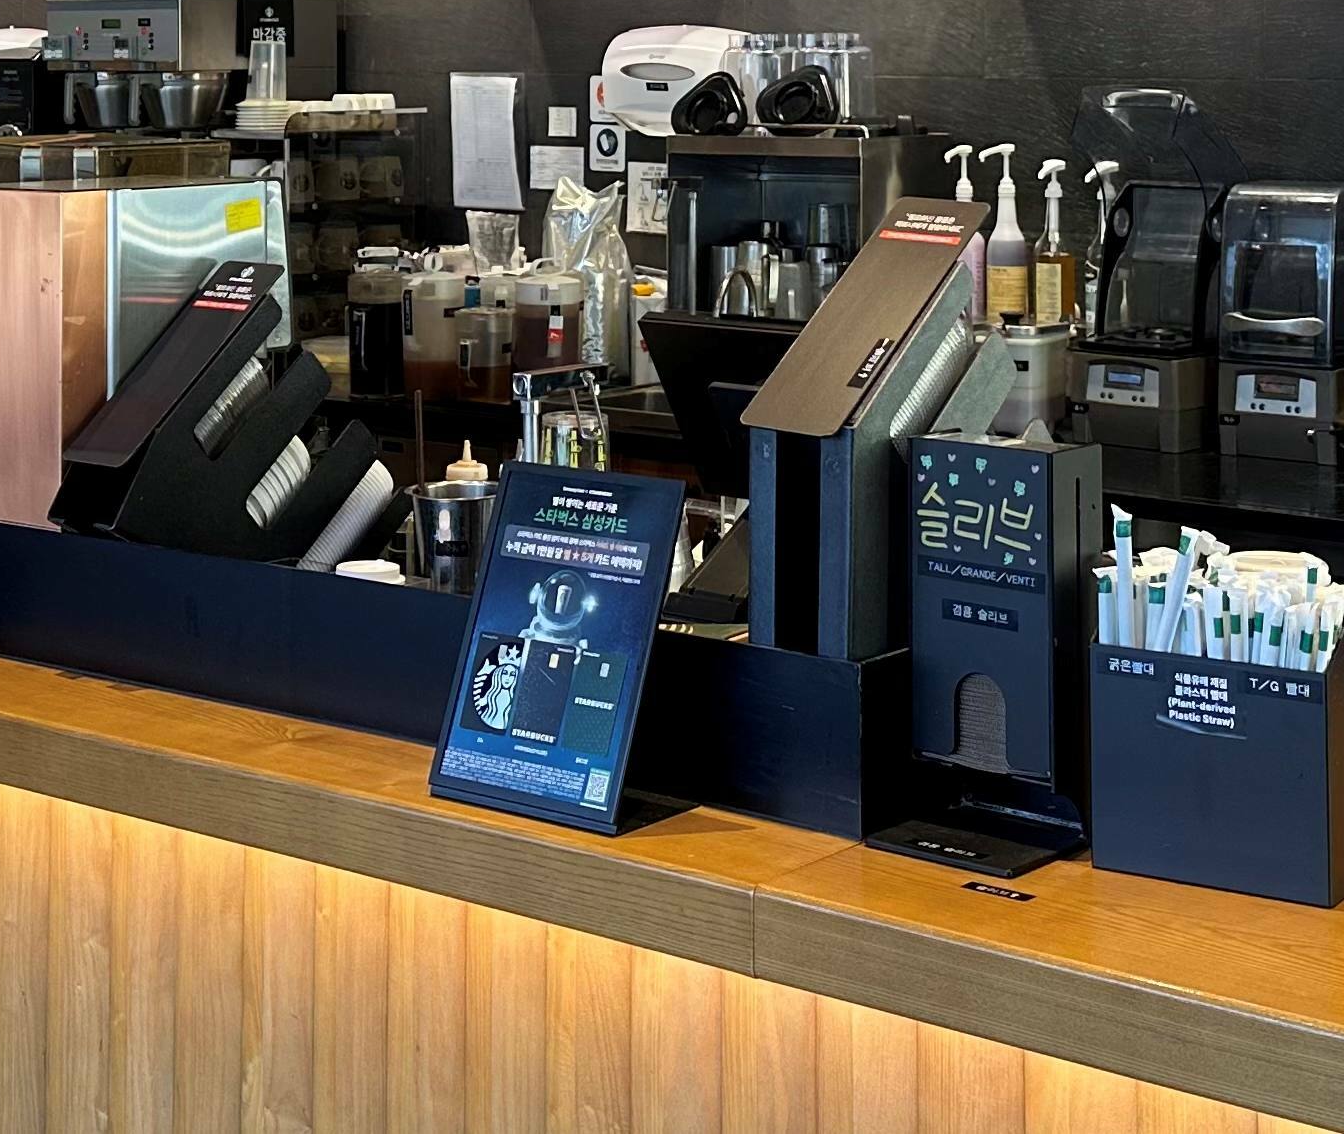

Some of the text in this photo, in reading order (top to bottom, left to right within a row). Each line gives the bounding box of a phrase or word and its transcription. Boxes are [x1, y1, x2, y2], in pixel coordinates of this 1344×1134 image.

[252, 27, 287, 41] 마감중
[534, 505, 628, 534] 스타벅스 삼성카드
[916, 481, 1034, 552] 슬리브
[928, 561, 1035, 587] TALL/GRANDE/VENTI
[978, 608, 1009, 624] 슬리브
[1108, 657, 1155, 676] 굵은빨대
[1249, 677, 1310, 698] T/G 빨대
[574, 696, 615, 711] STARBUCKS
[1167, 696, 1236, 716] (Plant-derived
[1168, 710, 1235, 729] Plastic Straw)
[511, 728, 556, 744] STARBUCKS
